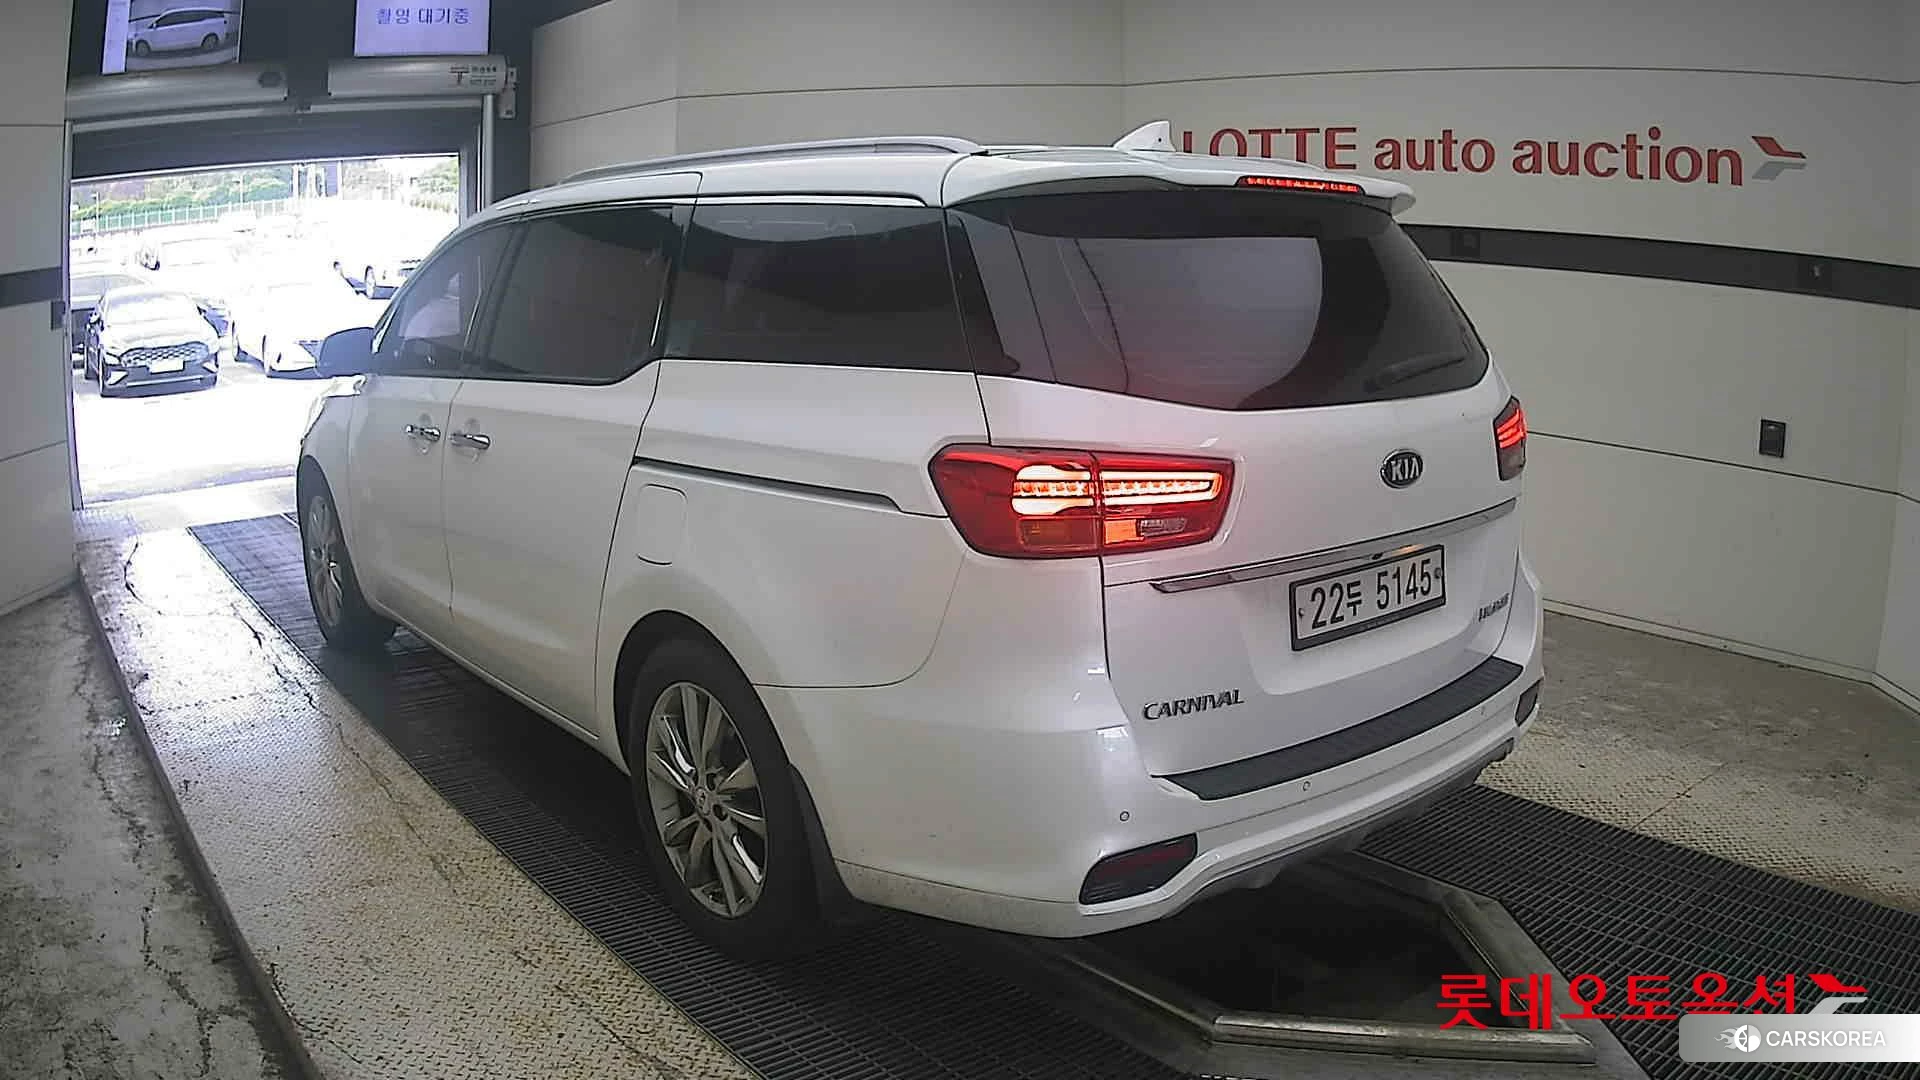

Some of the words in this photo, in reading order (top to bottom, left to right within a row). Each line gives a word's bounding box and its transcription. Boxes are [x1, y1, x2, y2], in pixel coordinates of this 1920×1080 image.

[418, 7, 470, 25] 대기중
[1374, 129, 1496, 173] auto
[1512, 126, 1744, 186] auction
[1388, 456, 1420, 481] KIA
[1310, 580, 1363, 630] 22두
[1375, 558, 1432, 610] 5145
[1143, 688, 1245, 720] CARNIVAL
